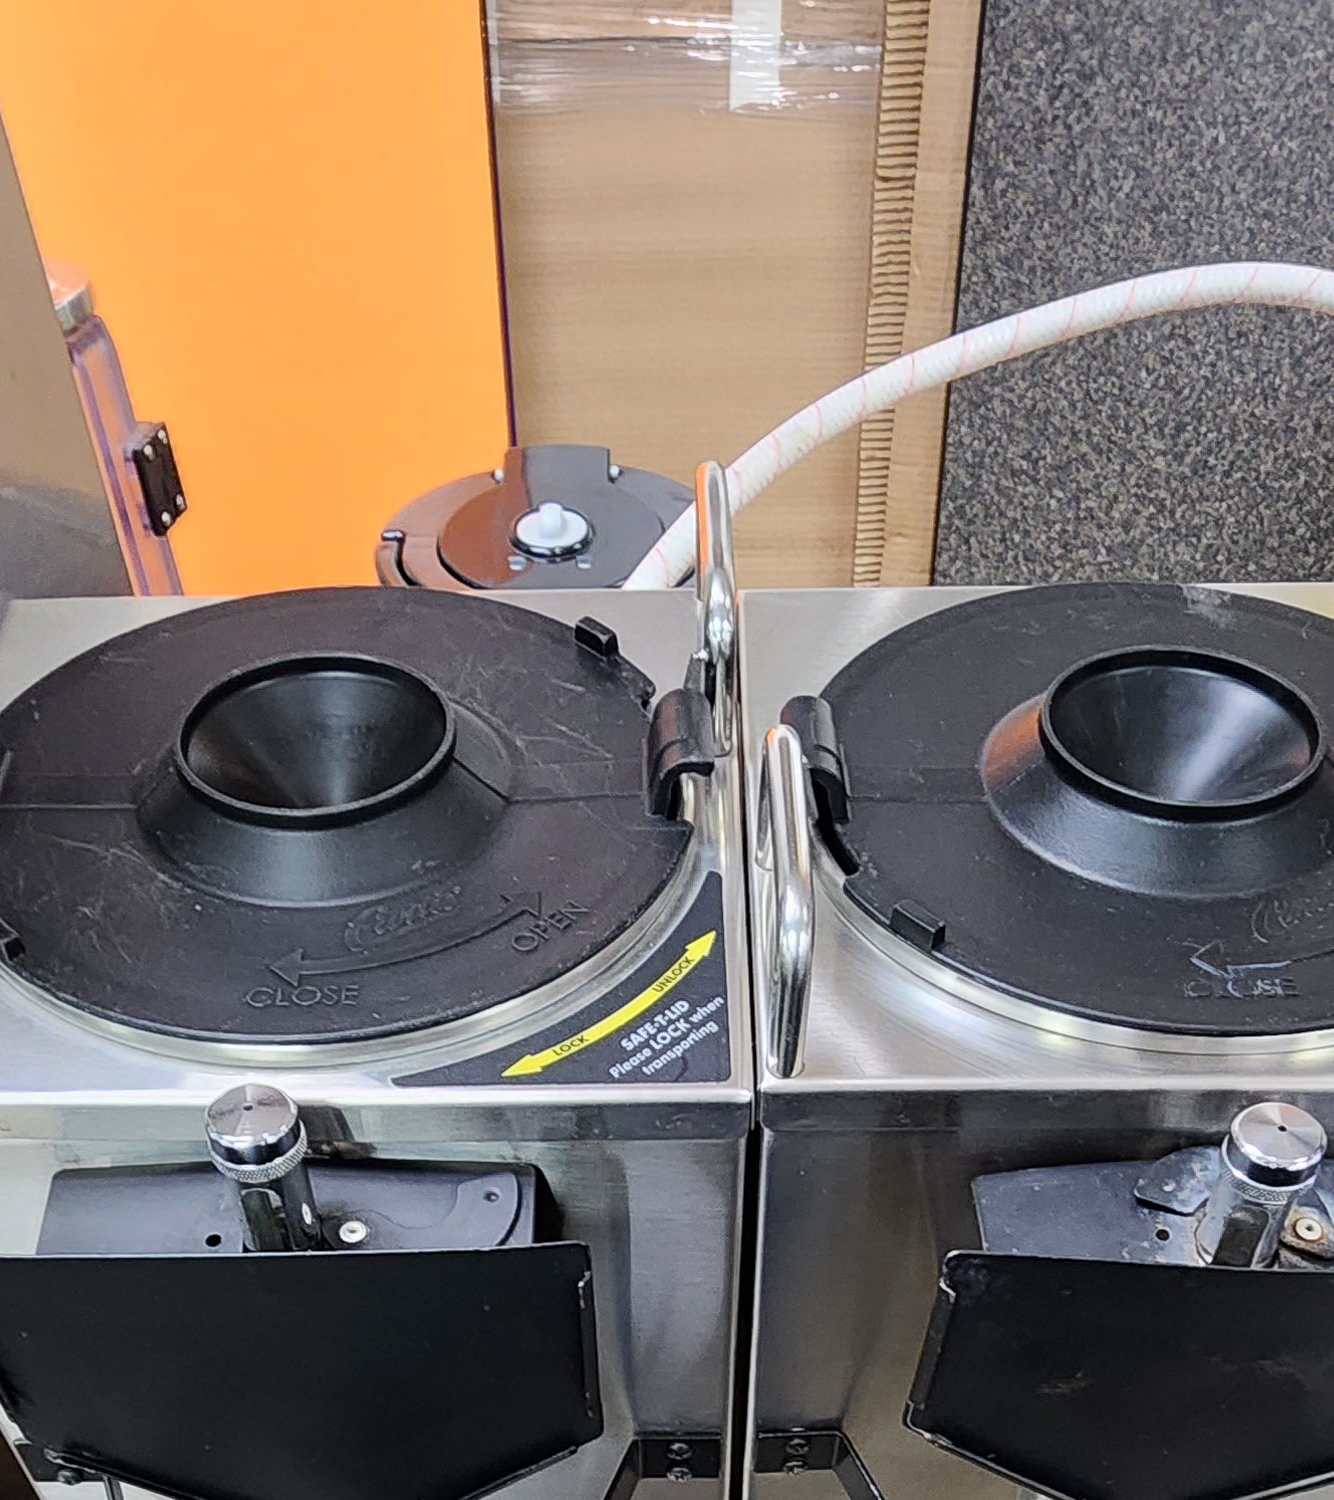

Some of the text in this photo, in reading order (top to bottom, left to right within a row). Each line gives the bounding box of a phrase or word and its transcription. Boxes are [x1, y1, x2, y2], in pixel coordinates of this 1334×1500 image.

[511, 899, 592, 952] OPEN
[243, 984, 362, 1007] CLOSE
[652, 956, 695, 993] UNLOCK
[551, 1034, 589, 1056] LOCK
[609, 996, 725, 1079] Please LOCK when
[641, 1020, 719, 1076] transporting
